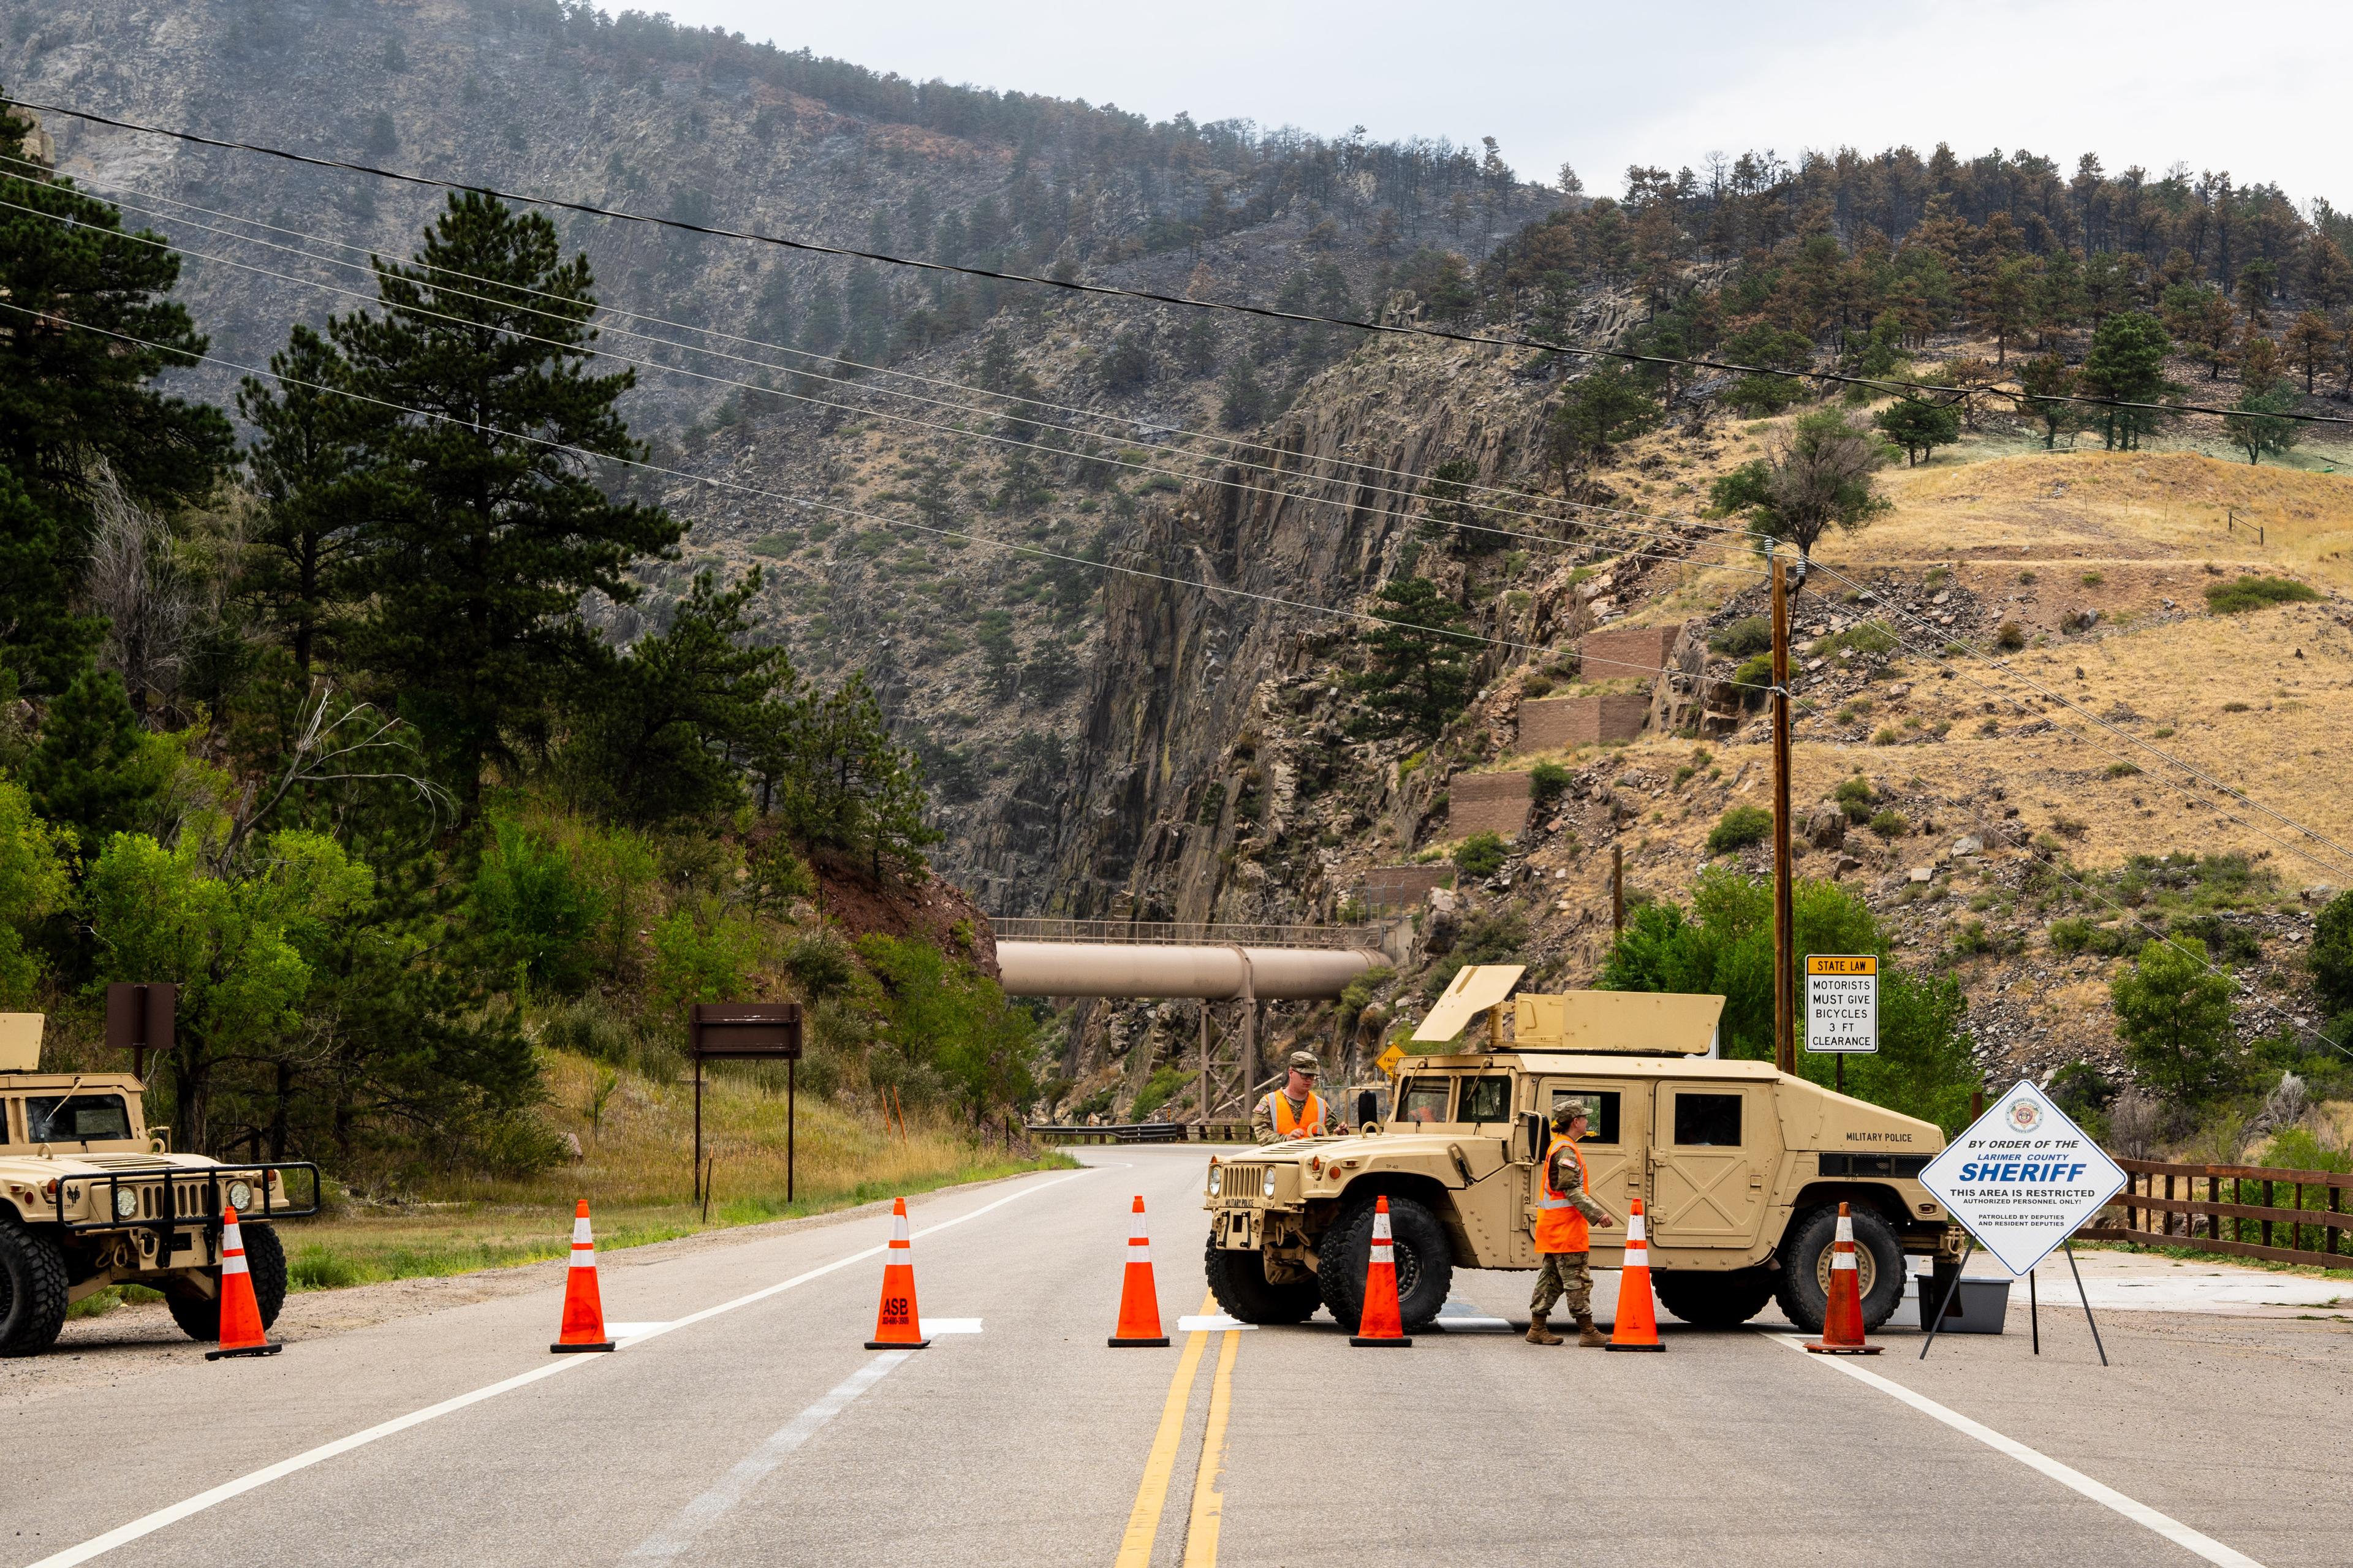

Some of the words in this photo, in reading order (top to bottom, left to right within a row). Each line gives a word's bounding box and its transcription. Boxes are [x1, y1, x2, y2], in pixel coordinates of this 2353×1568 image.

[1817, 961, 1845, 971] STATE
[1851, 961, 1866, 971] LAW
[1813, 980, 1870, 990] MOTORISTS
[1813, 994, 1843, 1004] MUST
[1847, 995, 1870, 1004] GIVE
[1816, 1009, 1868, 1018] BICYCLES
[1829, 1023, 1835, 1032] 3
[1843, 1023, 1854, 1032] FT
[1813, 1036, 1871, 1046] CLEARANCE
[1846, 1132, 1882, 1142] MILITARY
[1885, 1133, 1912, 1142] POLICE
[1988, 1140, 2031, 1149] ORDER
[2034, 1140, 2052, 1149] OF
[2055, 1140, 2080, 1149] THE
[1959, 1163, 2087, 1182] SHERIFF
[1226, 1199, 1241, 1207] MILITARY
[1242, 1199, 1254, 1207] POLICE
[883, 1298, 908, 1316] ASB
